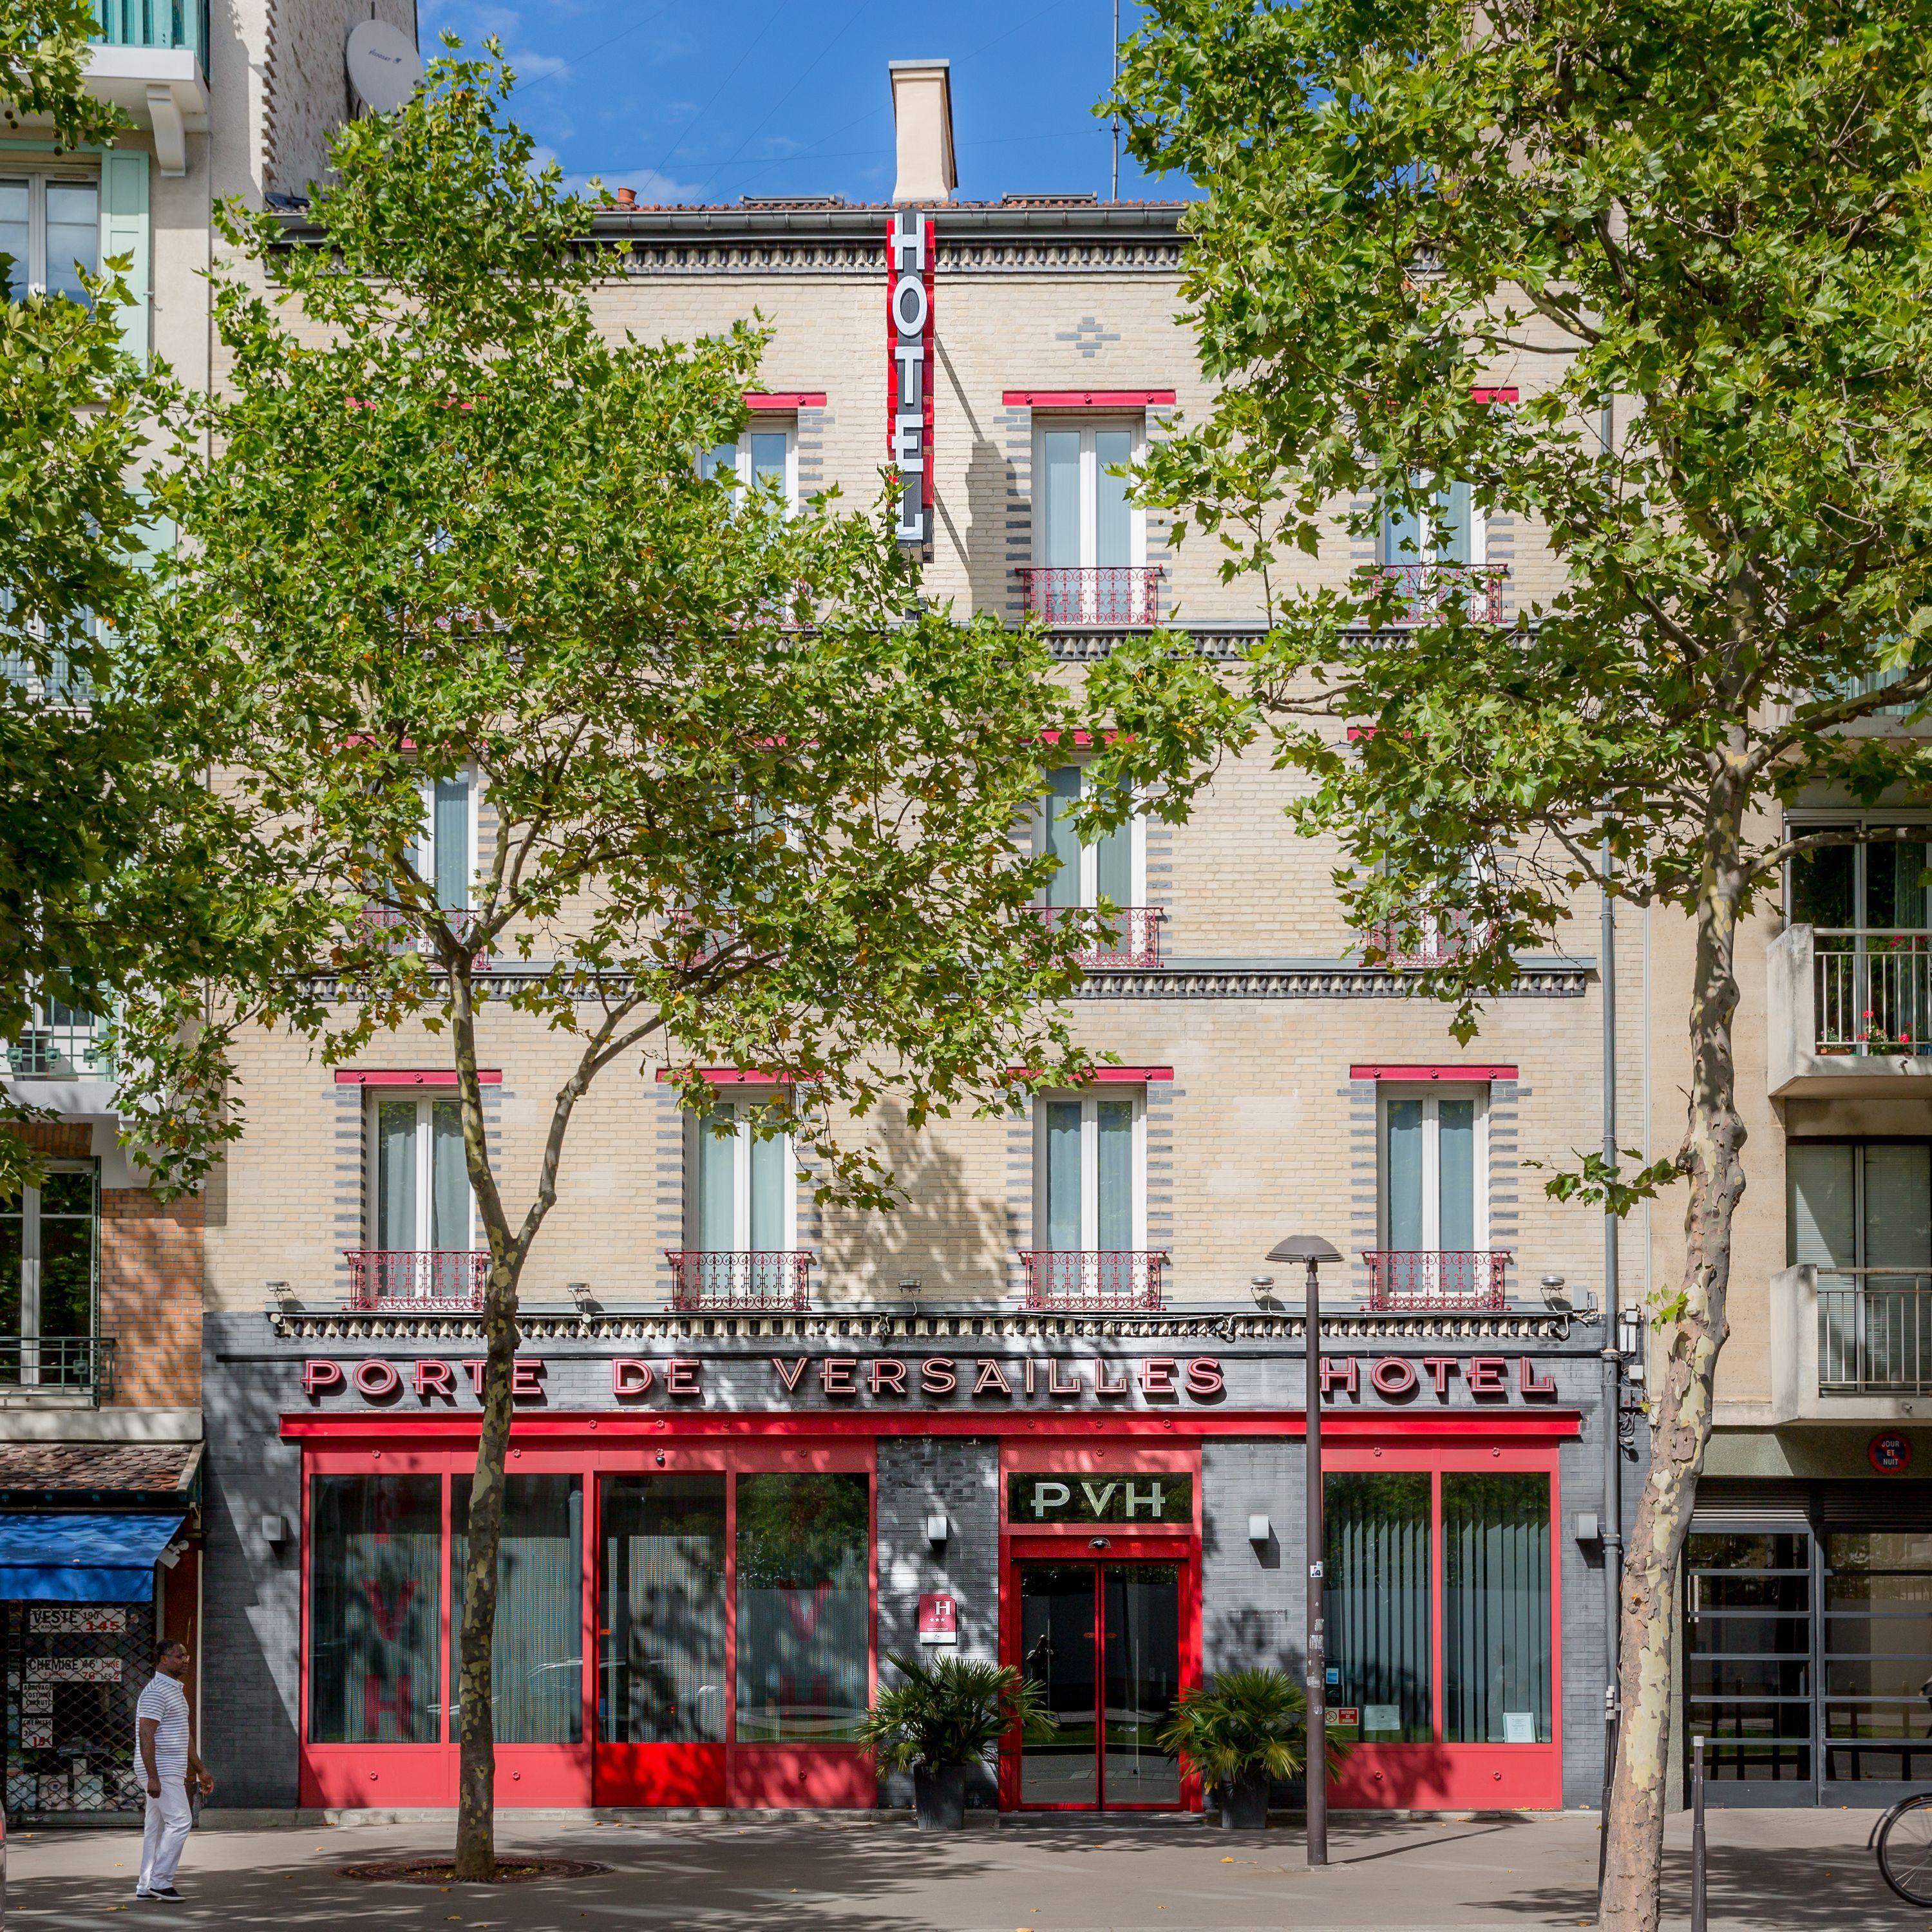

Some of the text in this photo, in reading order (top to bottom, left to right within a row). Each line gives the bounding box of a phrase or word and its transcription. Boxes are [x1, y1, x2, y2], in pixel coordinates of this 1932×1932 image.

[891, 213, 927, 540] HOTEL
[300, 1357, 1555, 1395] PORTE DE VERSAILLES HOTEL
[1030, 1482, 1166, 1517] PVH
[934, 1600, 952, 1615] H
[33, 1610, 78, 1624] VESTE
[86, 1621, 120, 1631] 145
[29, 1659, 79, 1671] CHEMISE
[113, 1671, 120, 1680] 2
